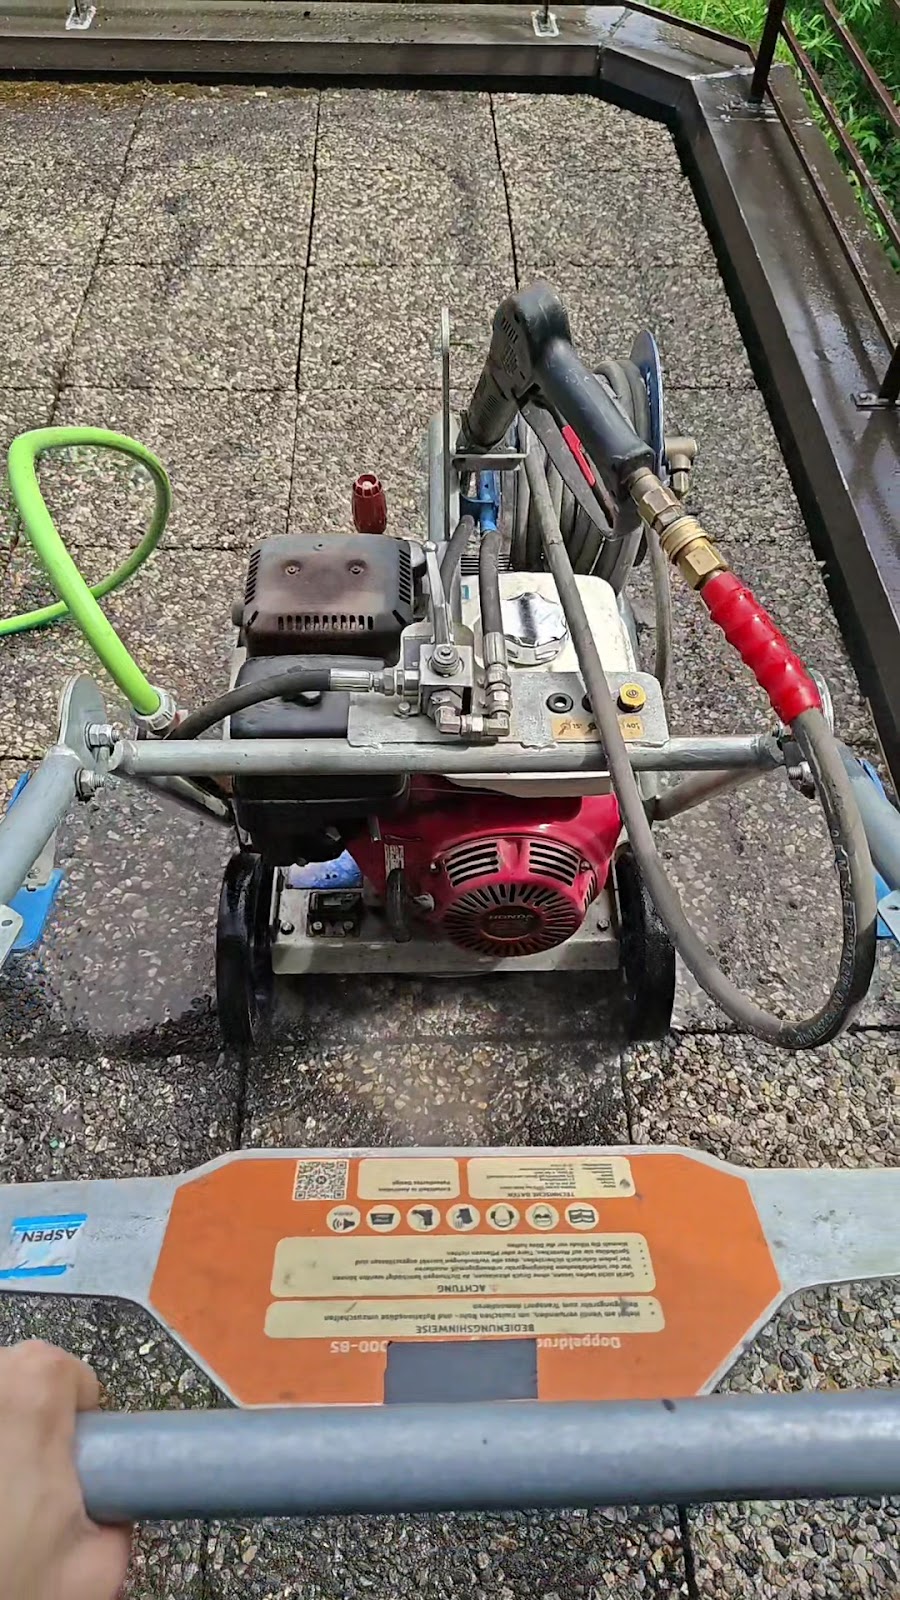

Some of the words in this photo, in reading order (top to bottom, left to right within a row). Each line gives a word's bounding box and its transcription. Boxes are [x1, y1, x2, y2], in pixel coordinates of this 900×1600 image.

[21, 1228, 78, 1243] ASPEN
[437, 1284, 486, 1293] ACHTUNG
[416, 1324, 534, 1334] BEDIENUNGSHINWEISE
